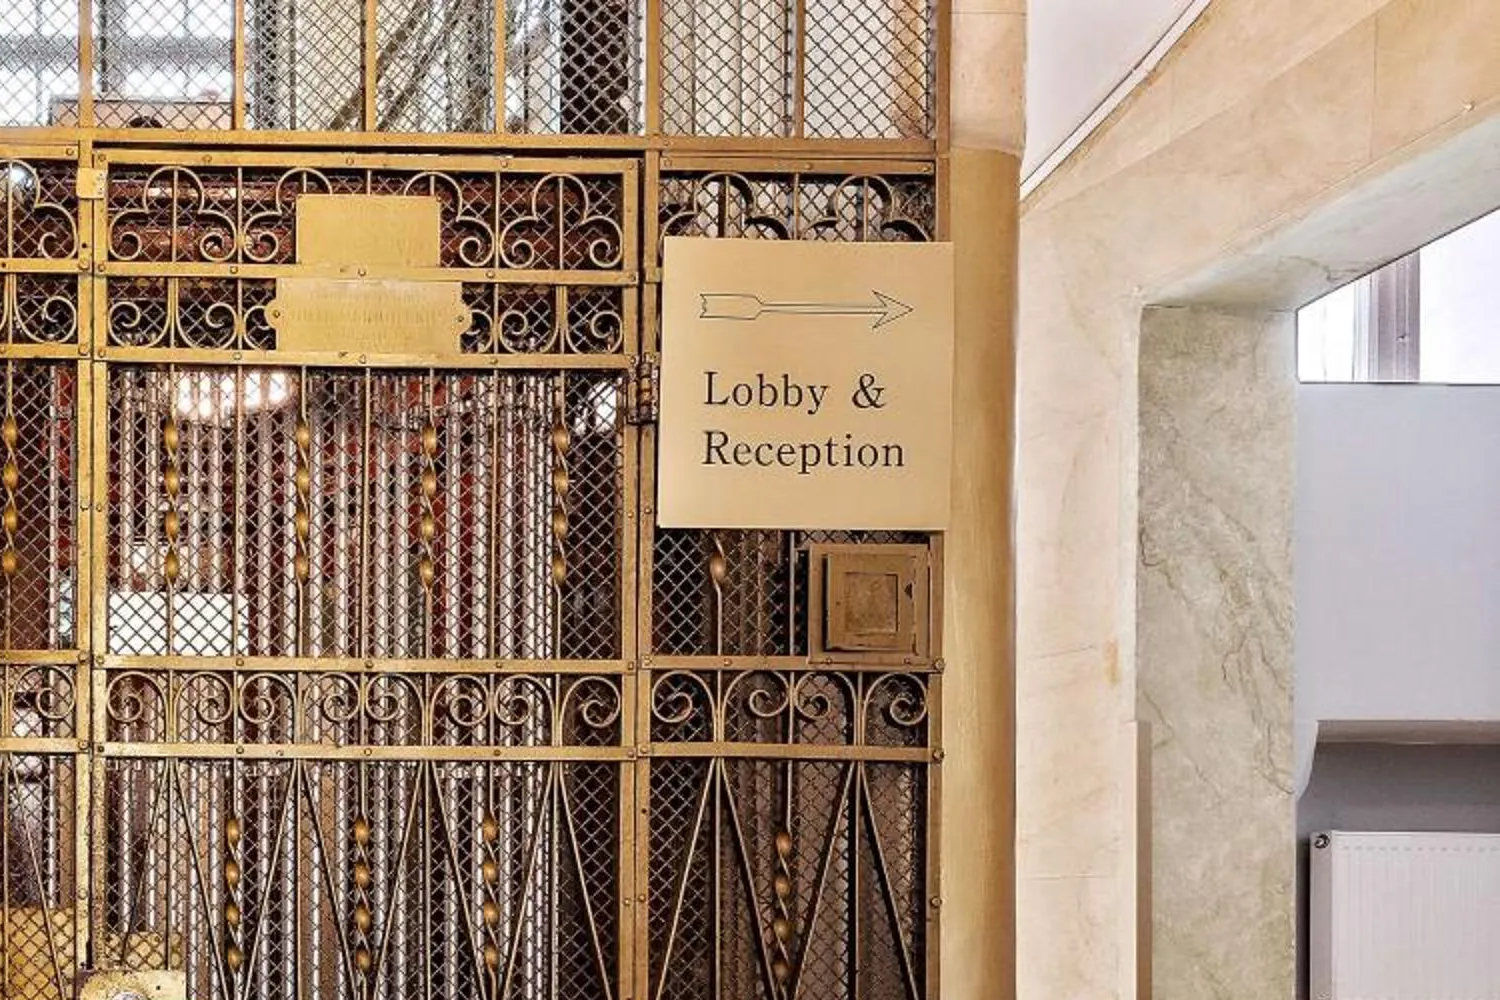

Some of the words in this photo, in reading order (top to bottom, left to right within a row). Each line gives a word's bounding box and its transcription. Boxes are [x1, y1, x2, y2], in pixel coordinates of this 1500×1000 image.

[703, 371, 829, 415] Lobby
[852, 373, 887, 409] &
[701, 430, 905, 475] Reception
